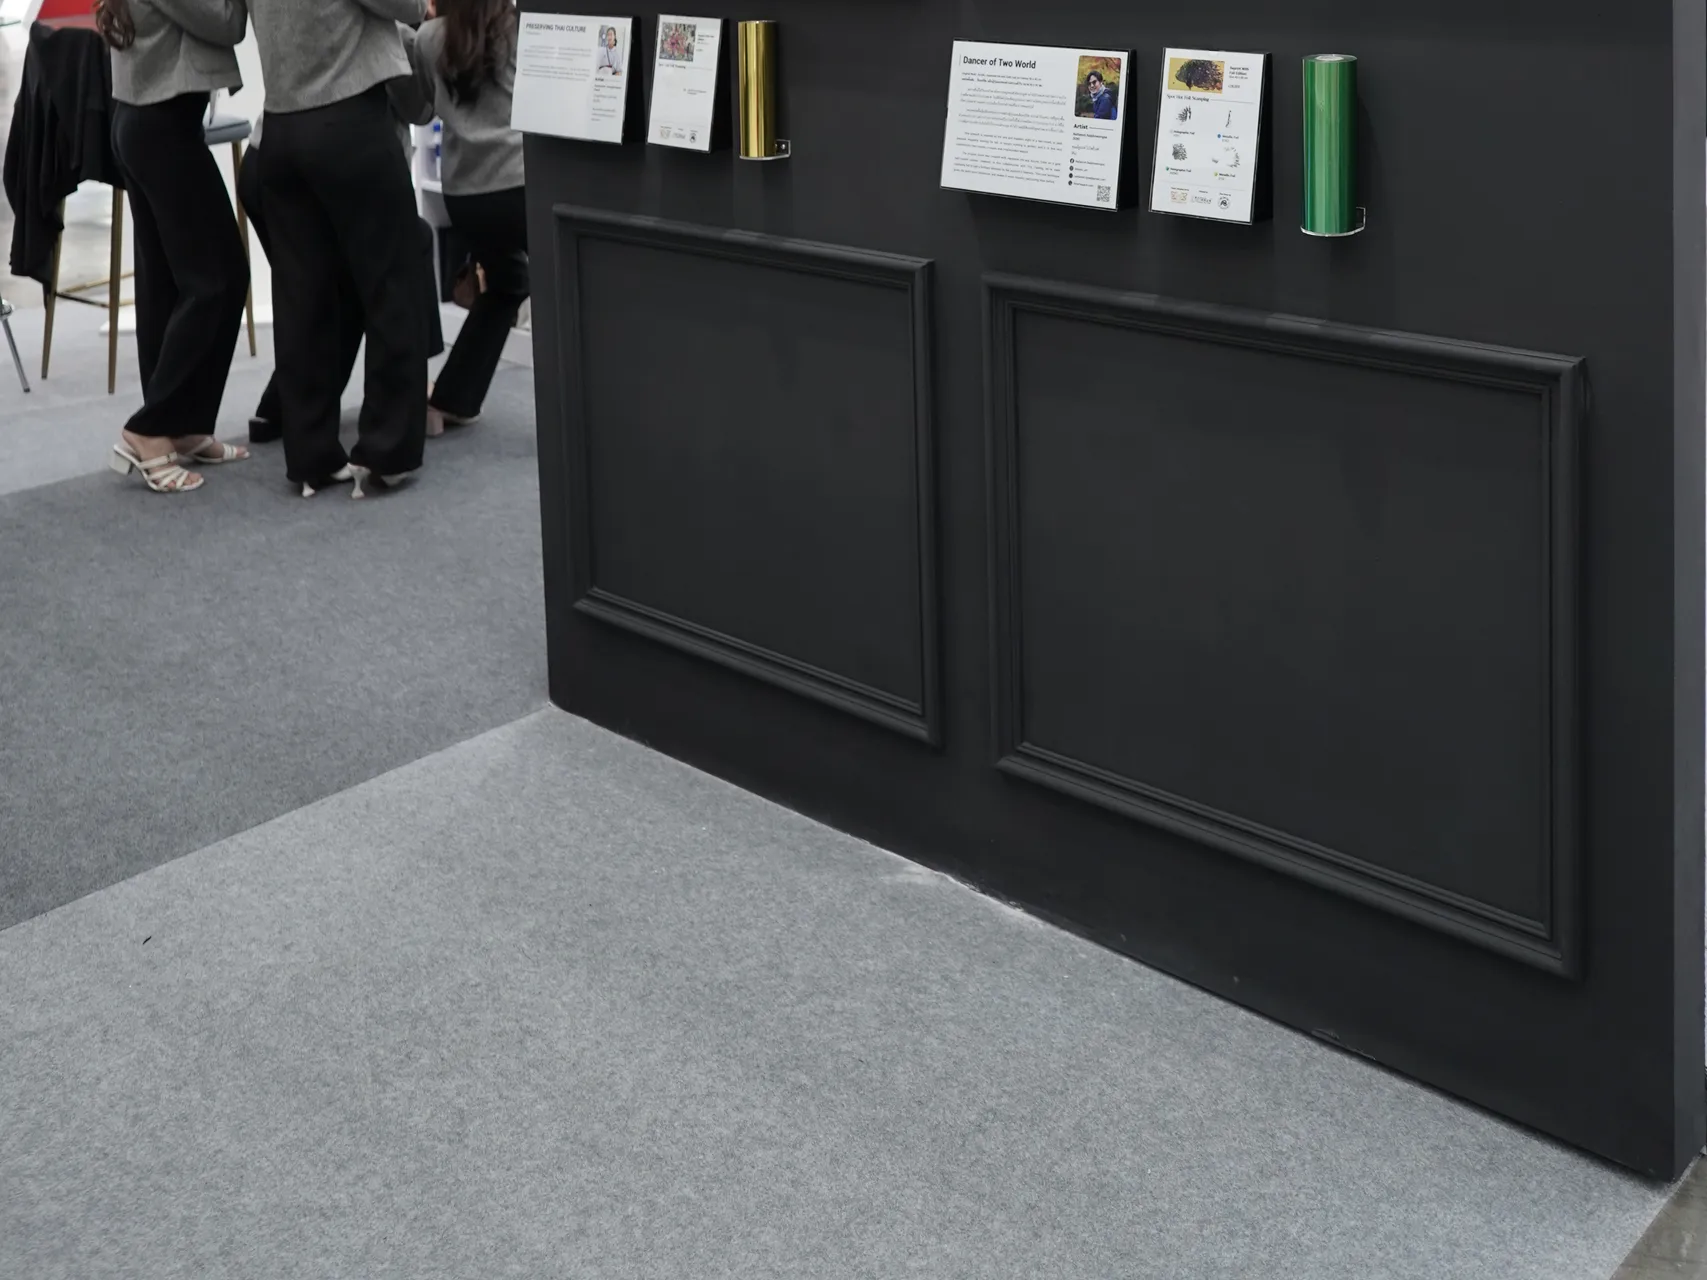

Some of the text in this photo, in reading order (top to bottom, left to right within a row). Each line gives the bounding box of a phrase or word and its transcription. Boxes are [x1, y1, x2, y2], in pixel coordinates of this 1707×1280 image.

[526, 23, 554, 31] PRESERVING
[566, 25, 586, 33] CULTURE
[963, 56, 1036, 69] Dancer of Two World
